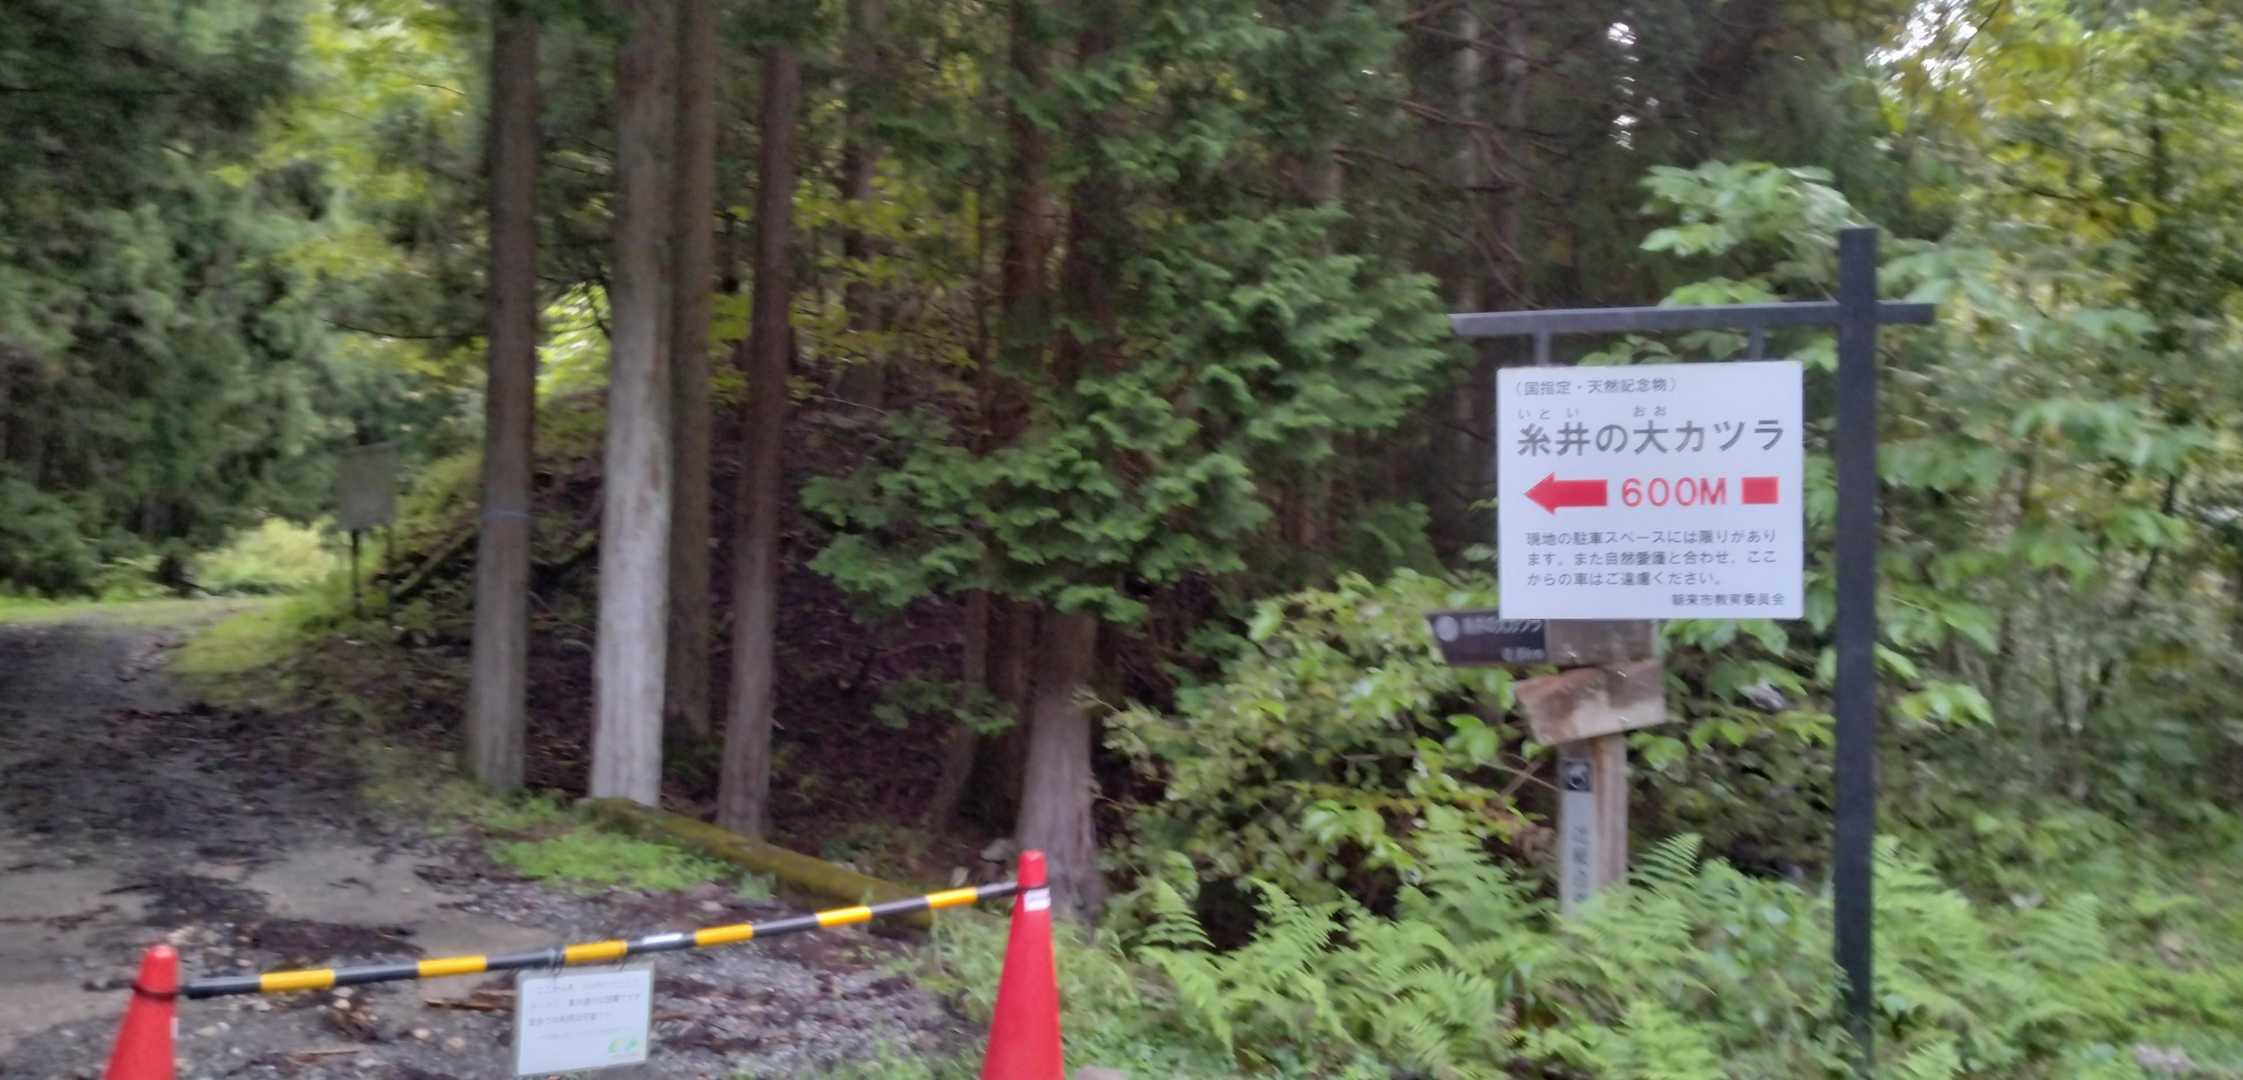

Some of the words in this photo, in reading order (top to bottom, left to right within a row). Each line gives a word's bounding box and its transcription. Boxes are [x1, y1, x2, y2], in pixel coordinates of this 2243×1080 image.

[1517, 419, 1784, 457] 糸井の大カツラ
[1621, 475, 1728, 508] 600M
